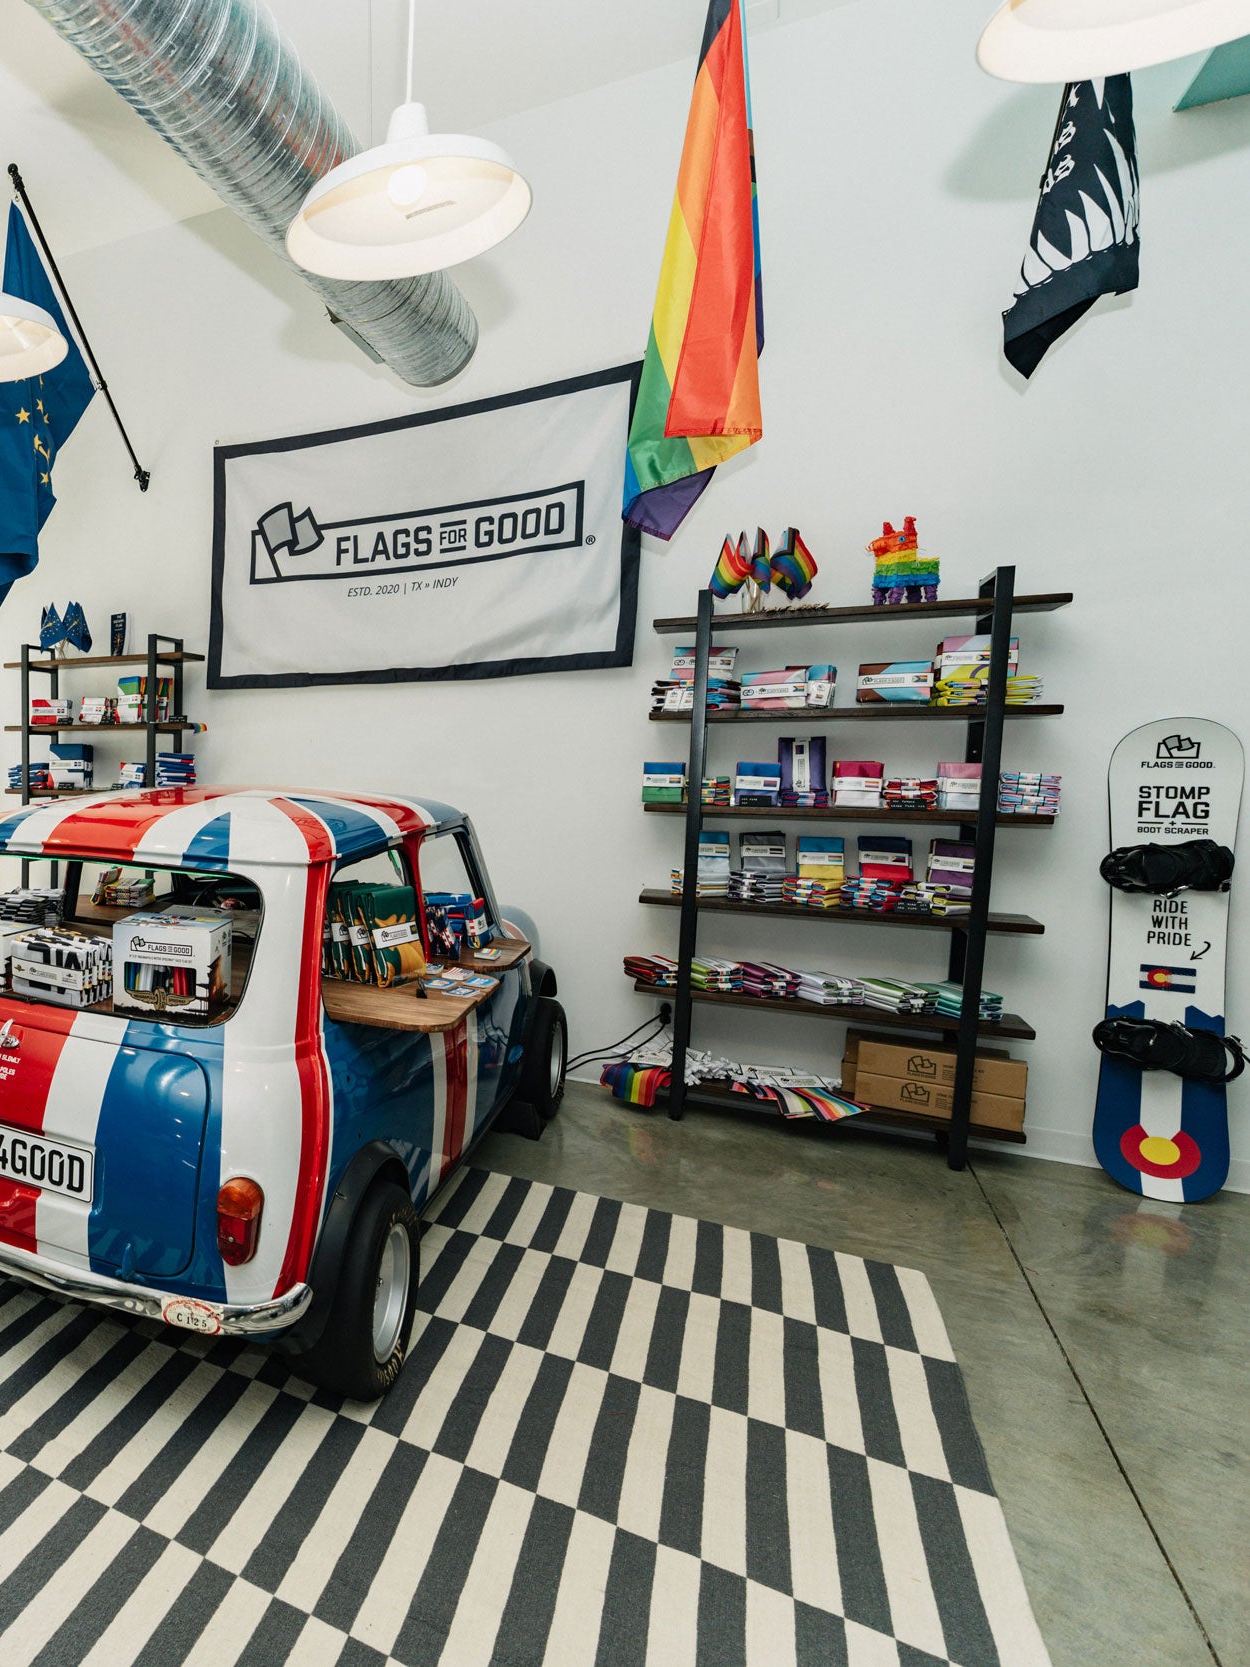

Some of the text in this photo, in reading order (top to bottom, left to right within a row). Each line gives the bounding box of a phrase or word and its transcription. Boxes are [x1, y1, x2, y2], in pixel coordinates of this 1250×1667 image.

[335, 501, 565, 566] FLAGS FOR GOOD
[347, 577, 459, 597] ESTD. 2020 TX INDY
[1185, 761, 1213, 769] GOOD
[1139, 785, 1211, 800] STOMP
[1138, 801, 1210, 819] FLAG
[1164, 827, 1209, 835] SCRAPER
[1153, 900, 1188, 914] RIDE
[1151, 915, 1188, 930] WITH
[1147, 930, 1192, 946] PRIDE
[148, 944, 167, 952] FLAGS
[173, 946, 190, 954] GOOD
[0, 1066, 16, 1076] POLES
